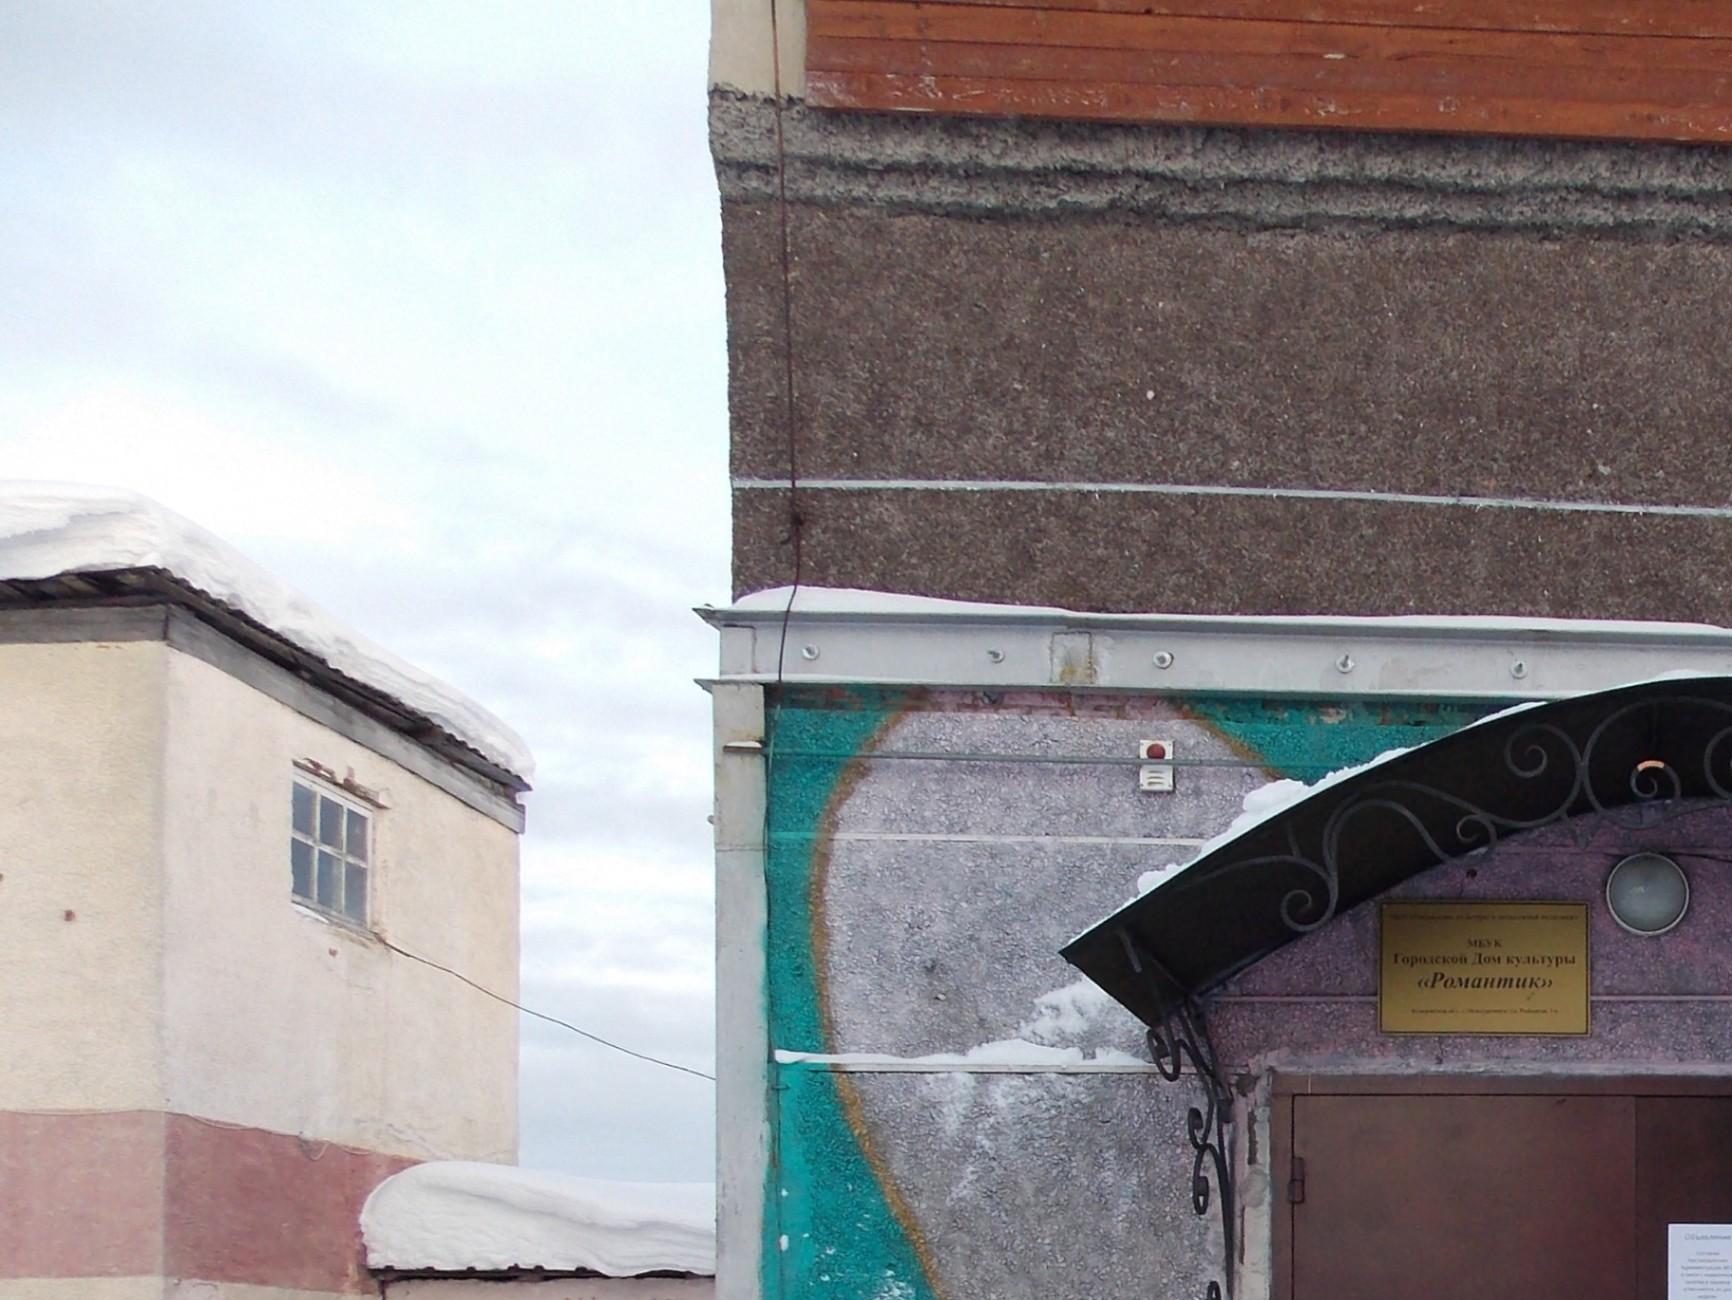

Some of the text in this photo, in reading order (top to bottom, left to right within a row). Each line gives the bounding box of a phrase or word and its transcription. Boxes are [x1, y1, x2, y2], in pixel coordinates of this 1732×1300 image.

[1467, 939, 1503, 949] МБУК
[1393, 953, 1576, 968] Городской Дом культуры
[1418, 971, 1553, 990] «Романтик»
